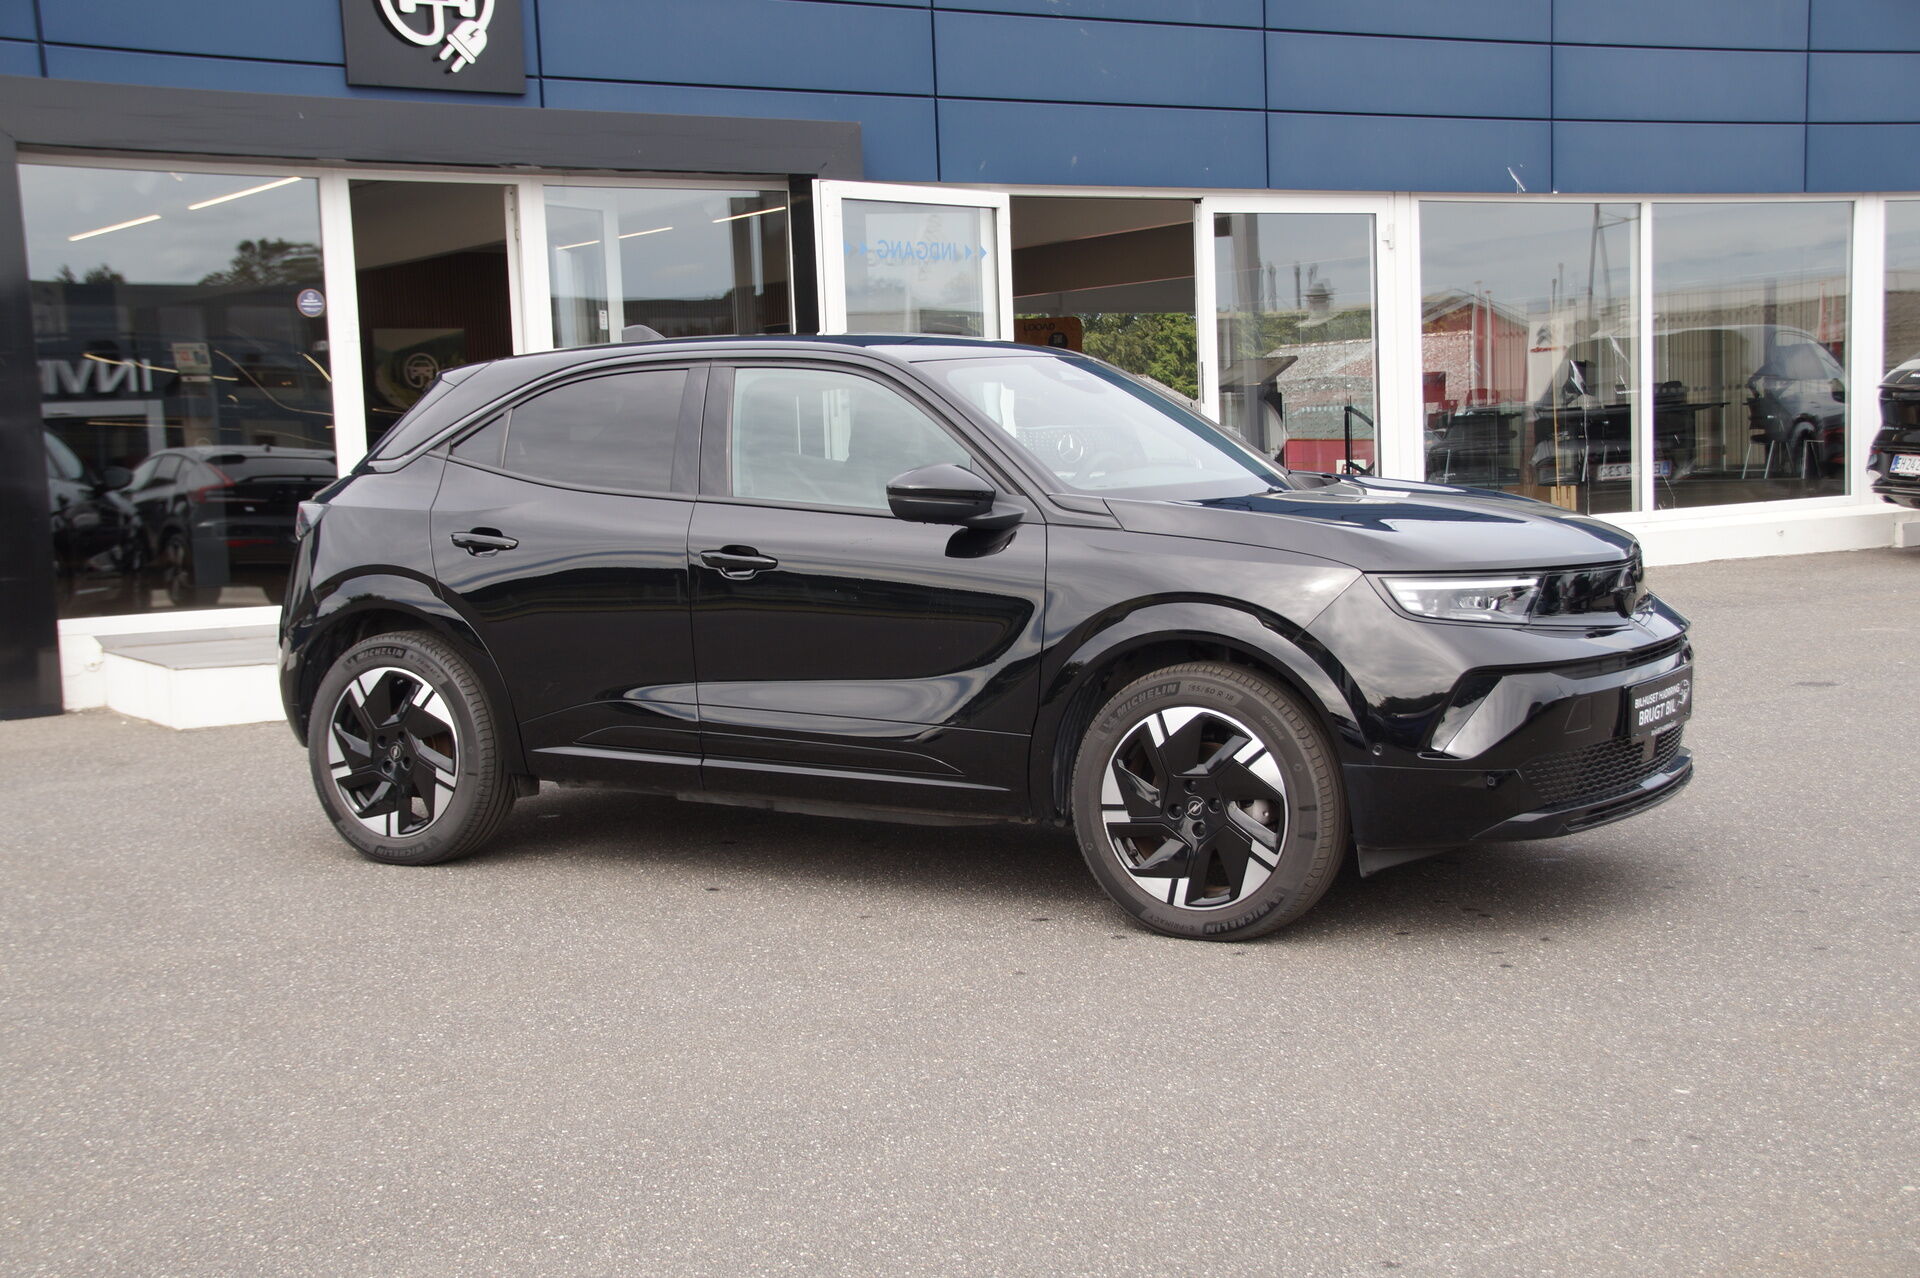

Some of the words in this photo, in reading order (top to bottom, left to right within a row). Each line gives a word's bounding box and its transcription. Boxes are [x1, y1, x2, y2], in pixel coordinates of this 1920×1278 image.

[1117, 684, 1178, 715] MICHELIN
[1639, 703, 1666, 726] BRUGT
[1666, 699, 1676, 715] BIL
